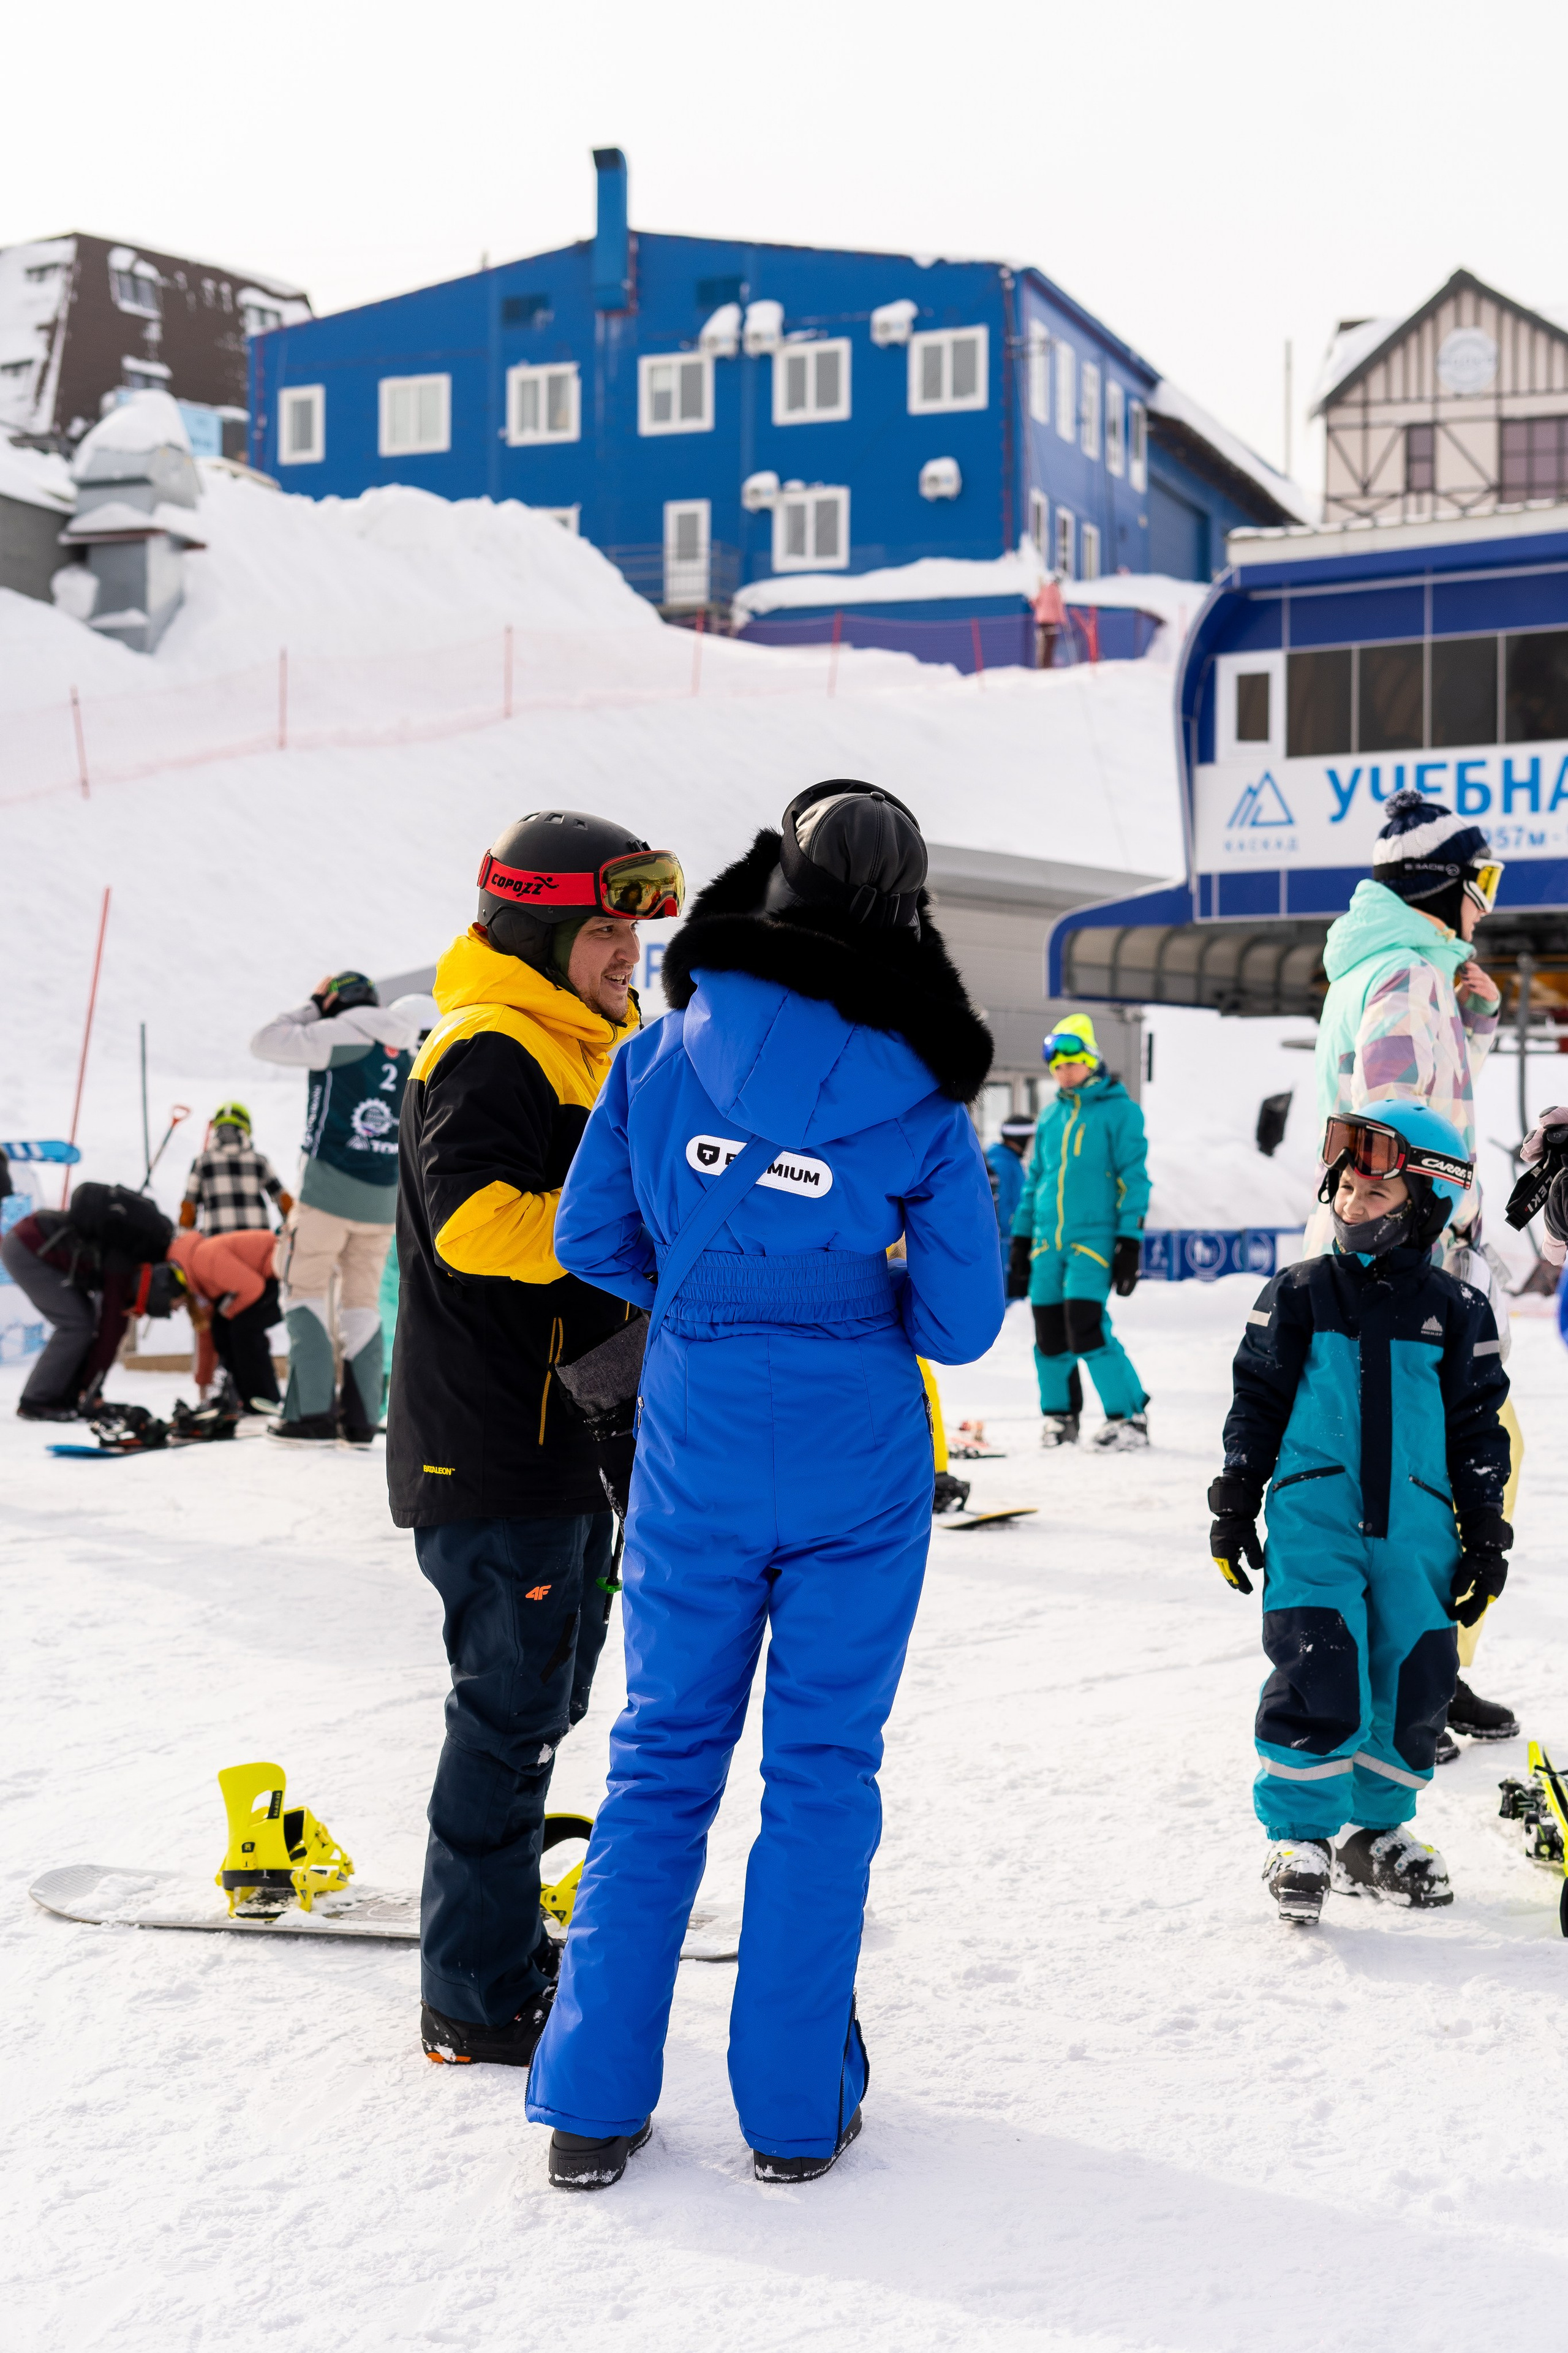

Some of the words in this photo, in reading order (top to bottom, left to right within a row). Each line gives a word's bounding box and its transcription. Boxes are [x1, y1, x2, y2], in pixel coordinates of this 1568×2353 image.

[491, 873, 545, 896] COPOZZ
[379, 1063, 398, 1092] 2
[725, 1152, 820, 1186] PMIUM
[1421, 1158, 1472, 1180] CARRE
[1527, 1175, 1553, 1213] LEKI
[526, 1585, 551, 1600] 4F
